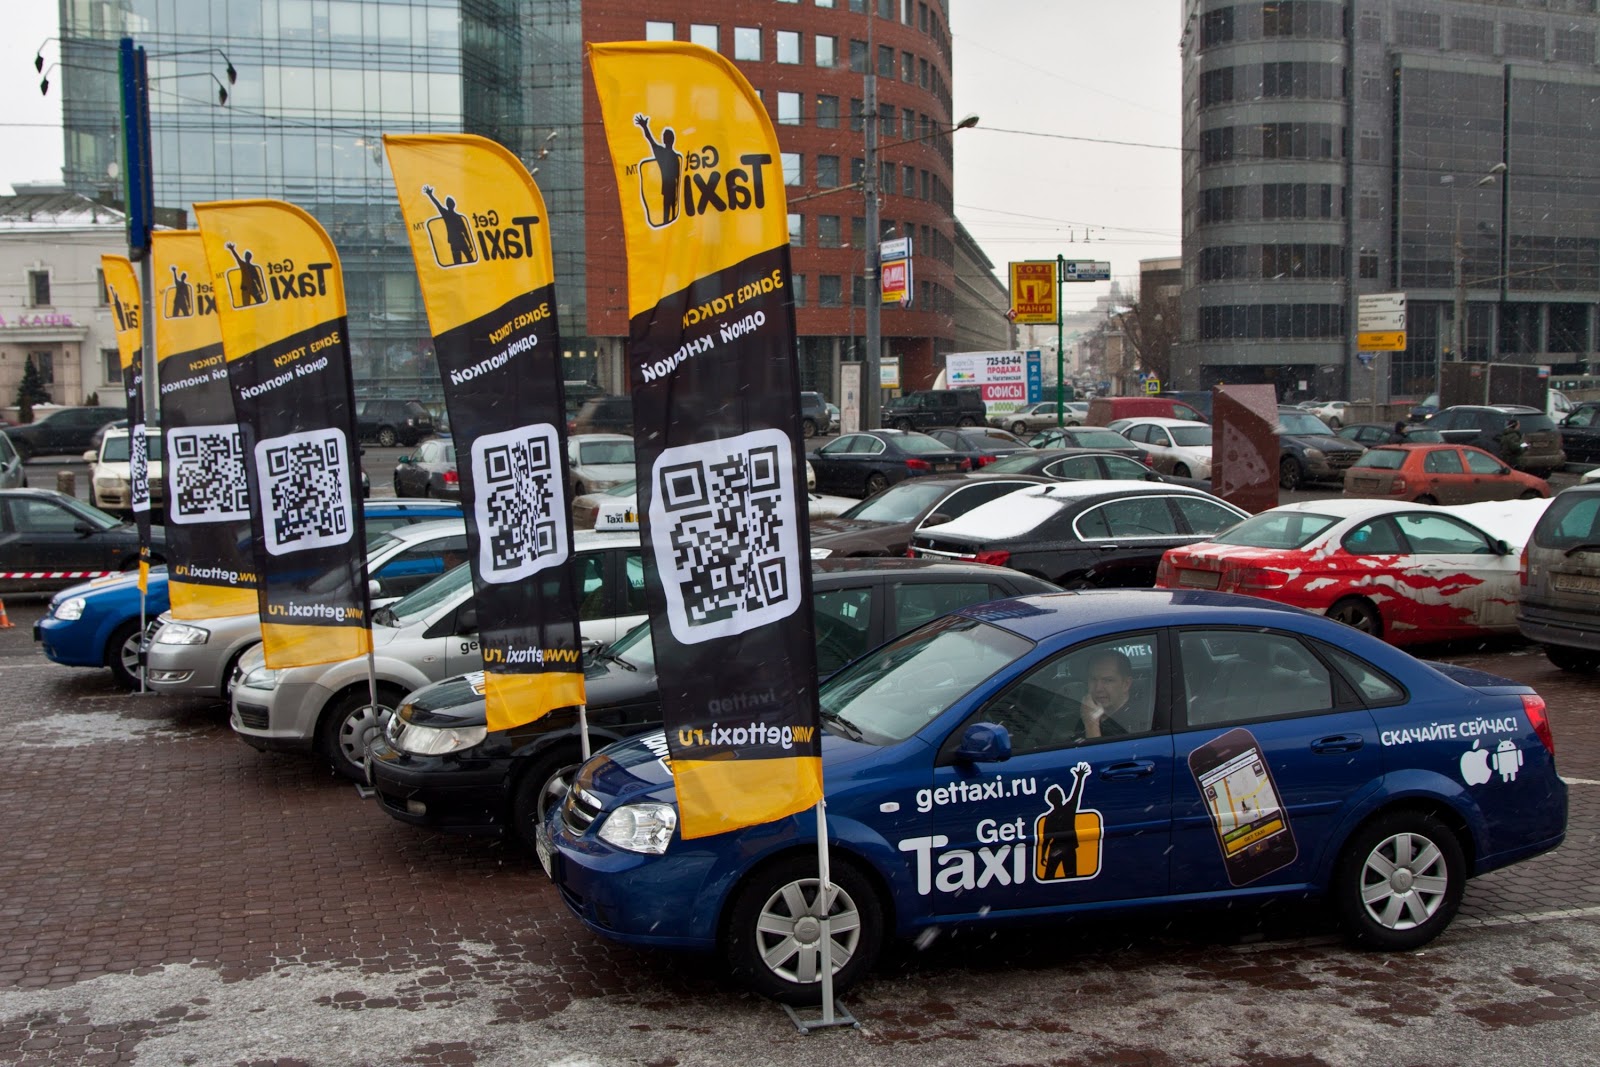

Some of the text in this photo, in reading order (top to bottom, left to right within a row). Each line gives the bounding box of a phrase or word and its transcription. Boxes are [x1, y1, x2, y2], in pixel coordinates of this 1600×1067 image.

[1017, 265, 1050, 273] КОФЕ
[987, 366, 1021, 374] ПРОДАЖА
[987, 385, 1022, 398] ОФИСЫ
[605, 514, 623, 523] Taxi
[1381, 717, 1518, 747] СКАЧАЙТЕ СЕЙЧАС!
[916, 775, 1037, 813] gettaxi.ru
[976, 816, 1027, 844] Get
[898, 833, 1027, 896] Taxi
